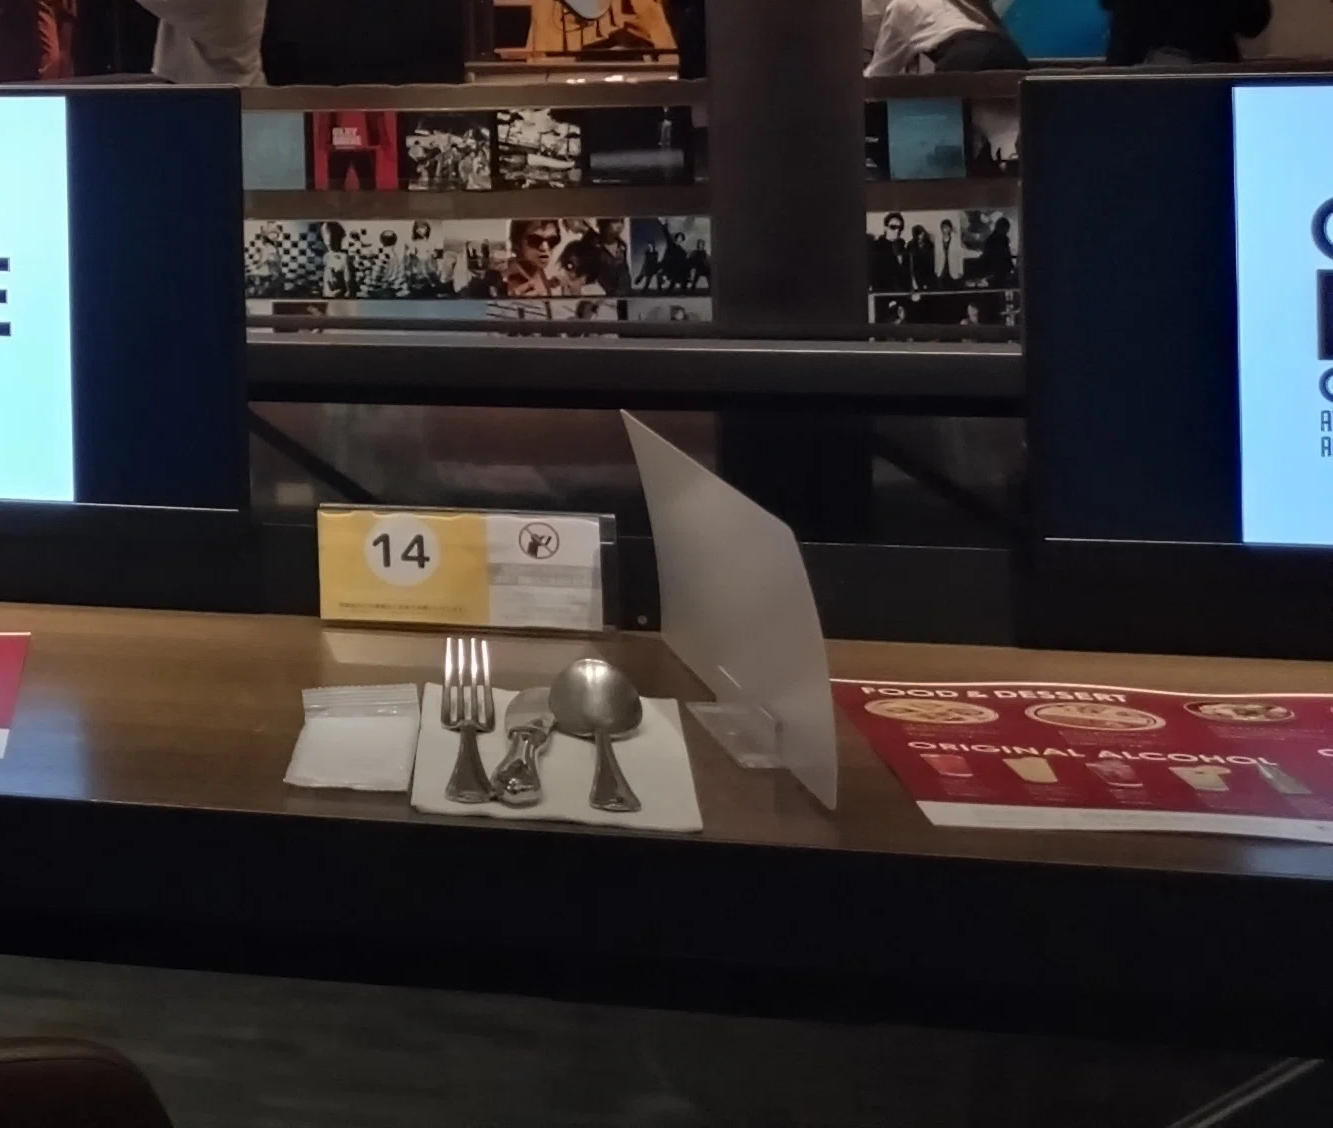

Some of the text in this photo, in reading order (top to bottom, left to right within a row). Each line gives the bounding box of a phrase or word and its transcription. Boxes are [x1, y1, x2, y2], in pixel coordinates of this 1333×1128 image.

[372, 533, 431, 569] 14
[861, 686, 1129, 704] FOOD & DESSERT
[907, 741, 1278, 766] ORIGINAL ALCOHOL
